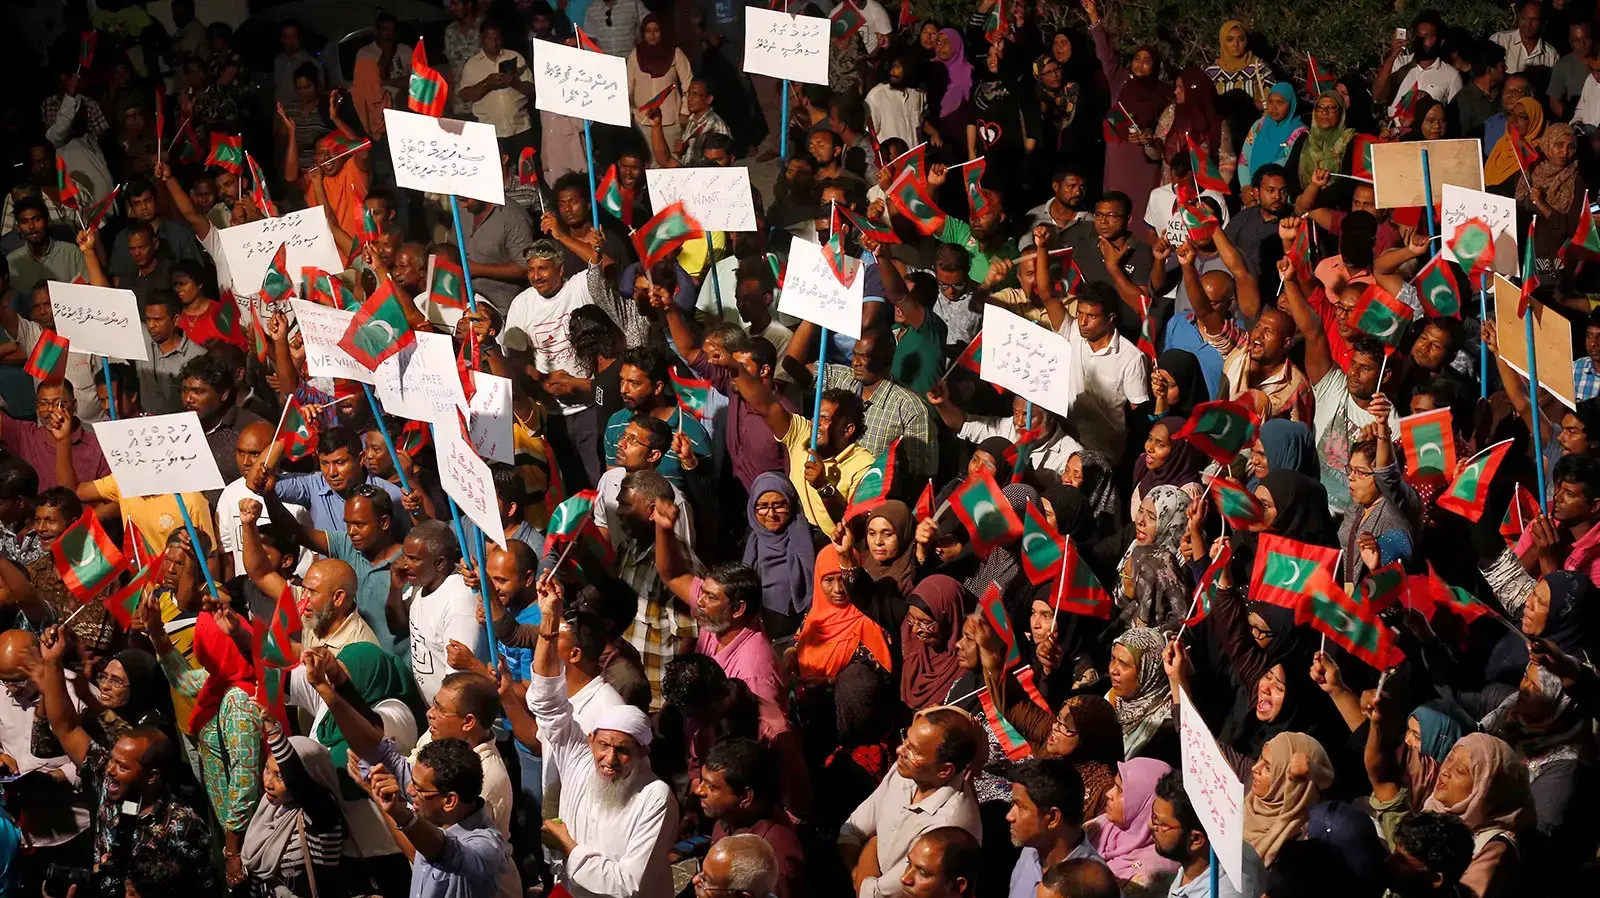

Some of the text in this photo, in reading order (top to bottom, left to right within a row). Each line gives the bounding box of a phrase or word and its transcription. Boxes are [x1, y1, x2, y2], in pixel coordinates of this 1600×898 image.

[691, 190, 720, 206] WANT
[1166, 232, 1189, 243] CAL
[311, 355, 333, 367] WE
[421, 373, 443, 386] FREE
